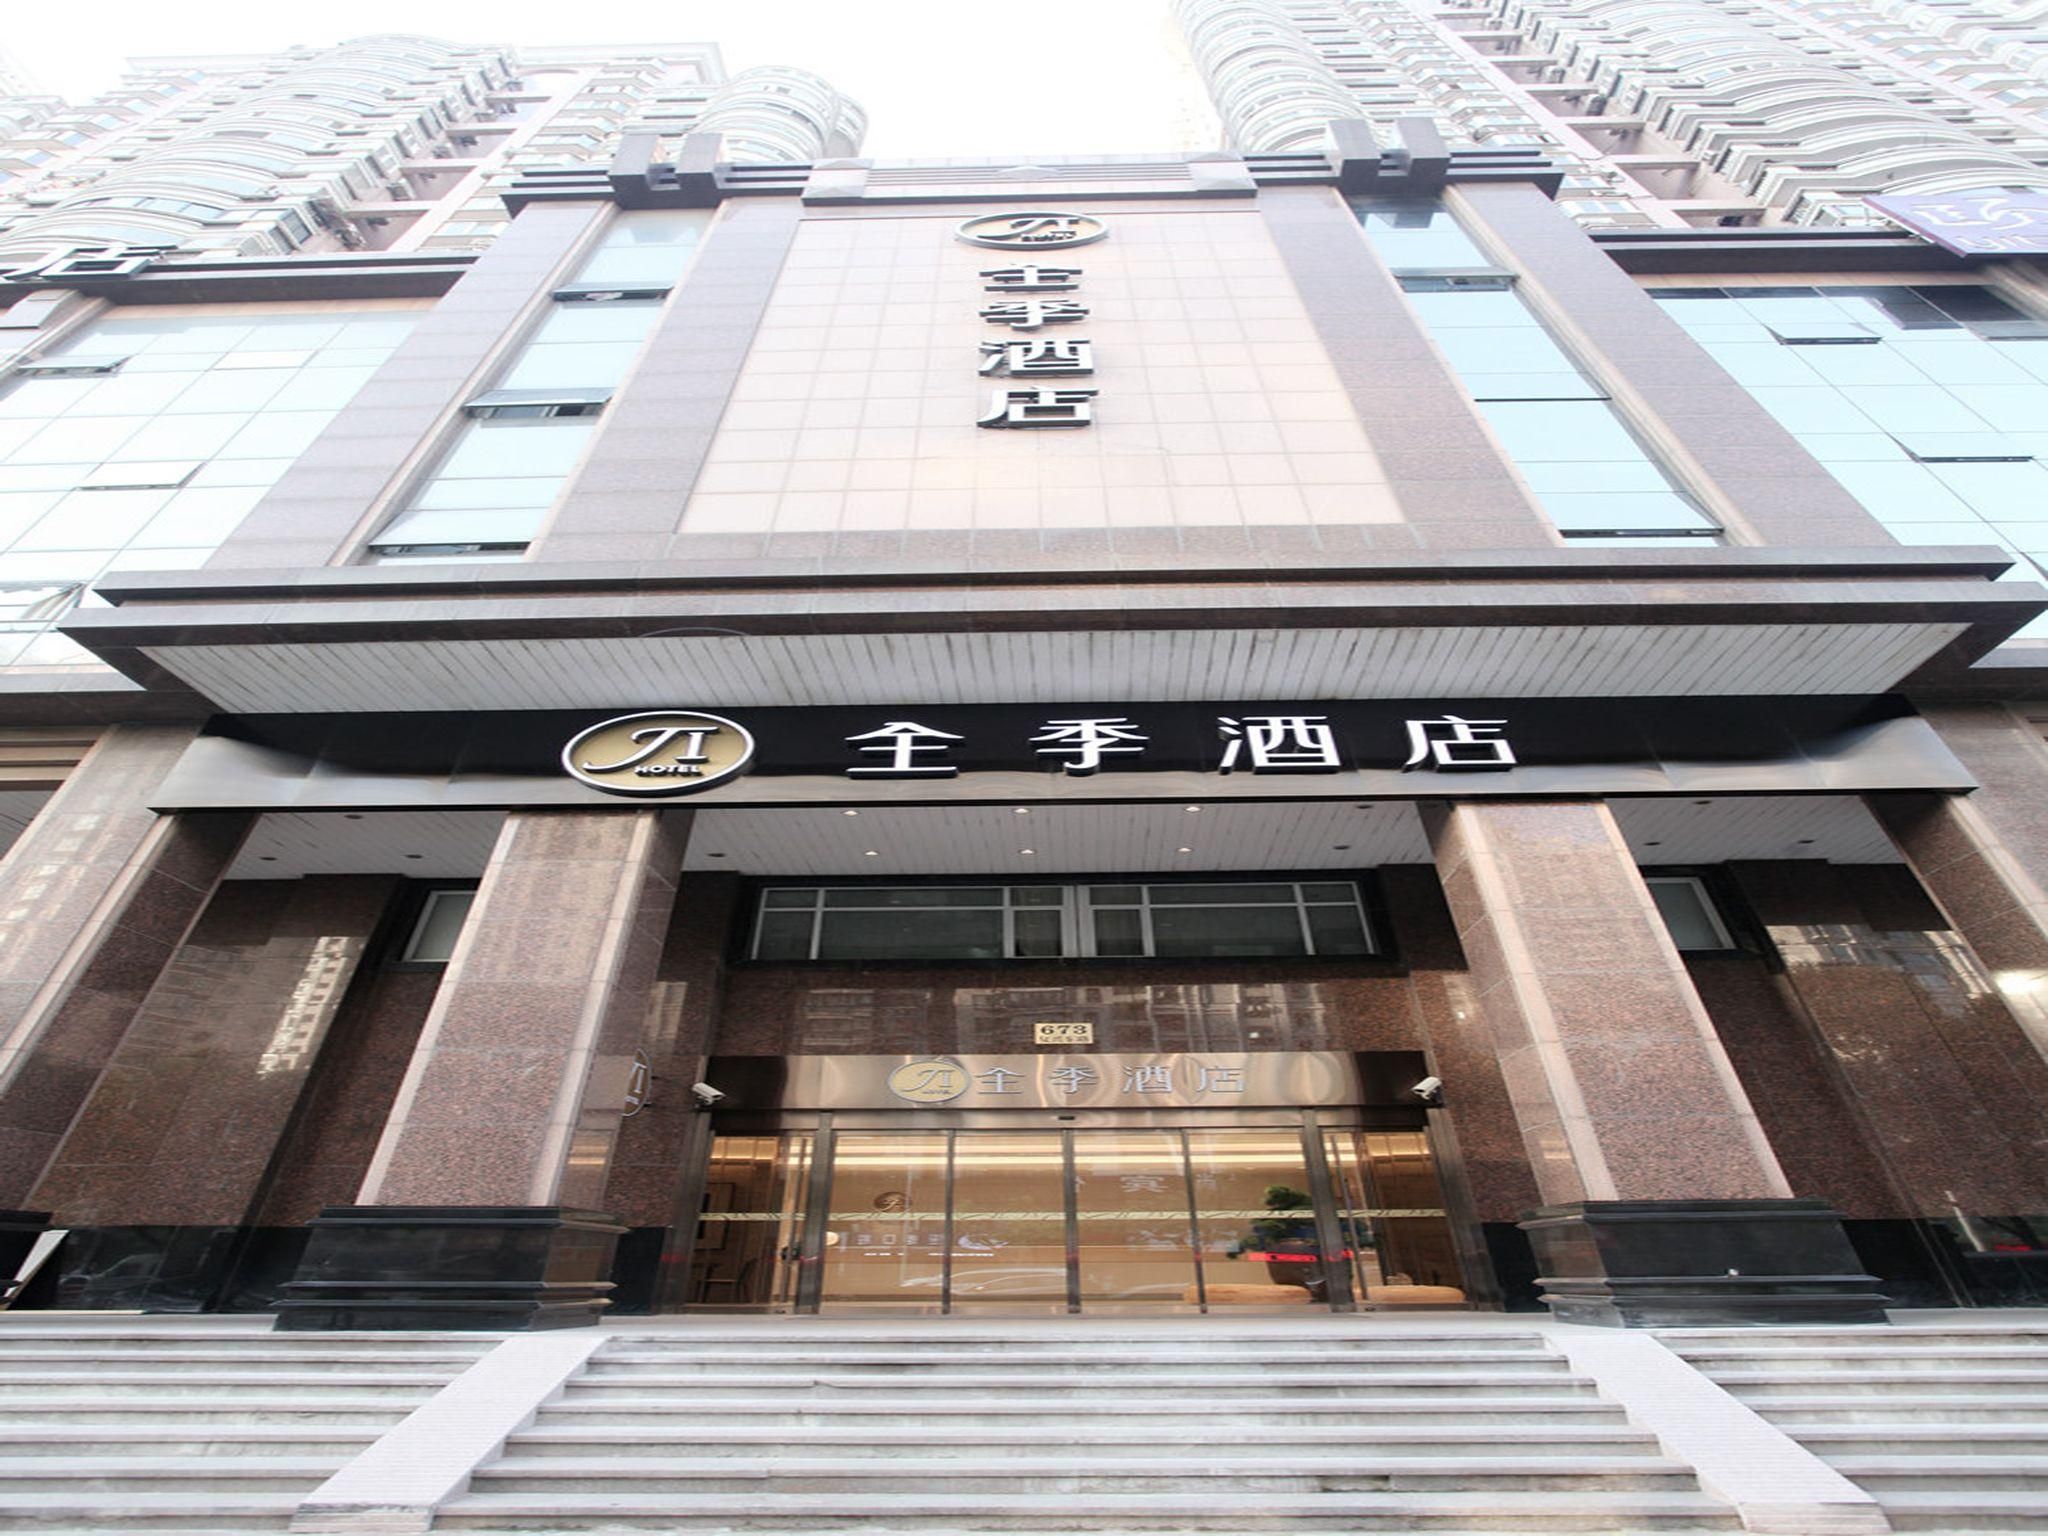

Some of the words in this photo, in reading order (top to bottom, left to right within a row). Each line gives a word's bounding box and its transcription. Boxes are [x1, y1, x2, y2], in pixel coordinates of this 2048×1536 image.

[976, 263, 1099, 429] 全季酒店
[845, 715, 1517, 776] 全季酒店
[635, 764, 704, 777] HOTEL
[1041, 1025, 1087, 1035] 673
[976, 1065, 1245, 1094] 全季酒店
